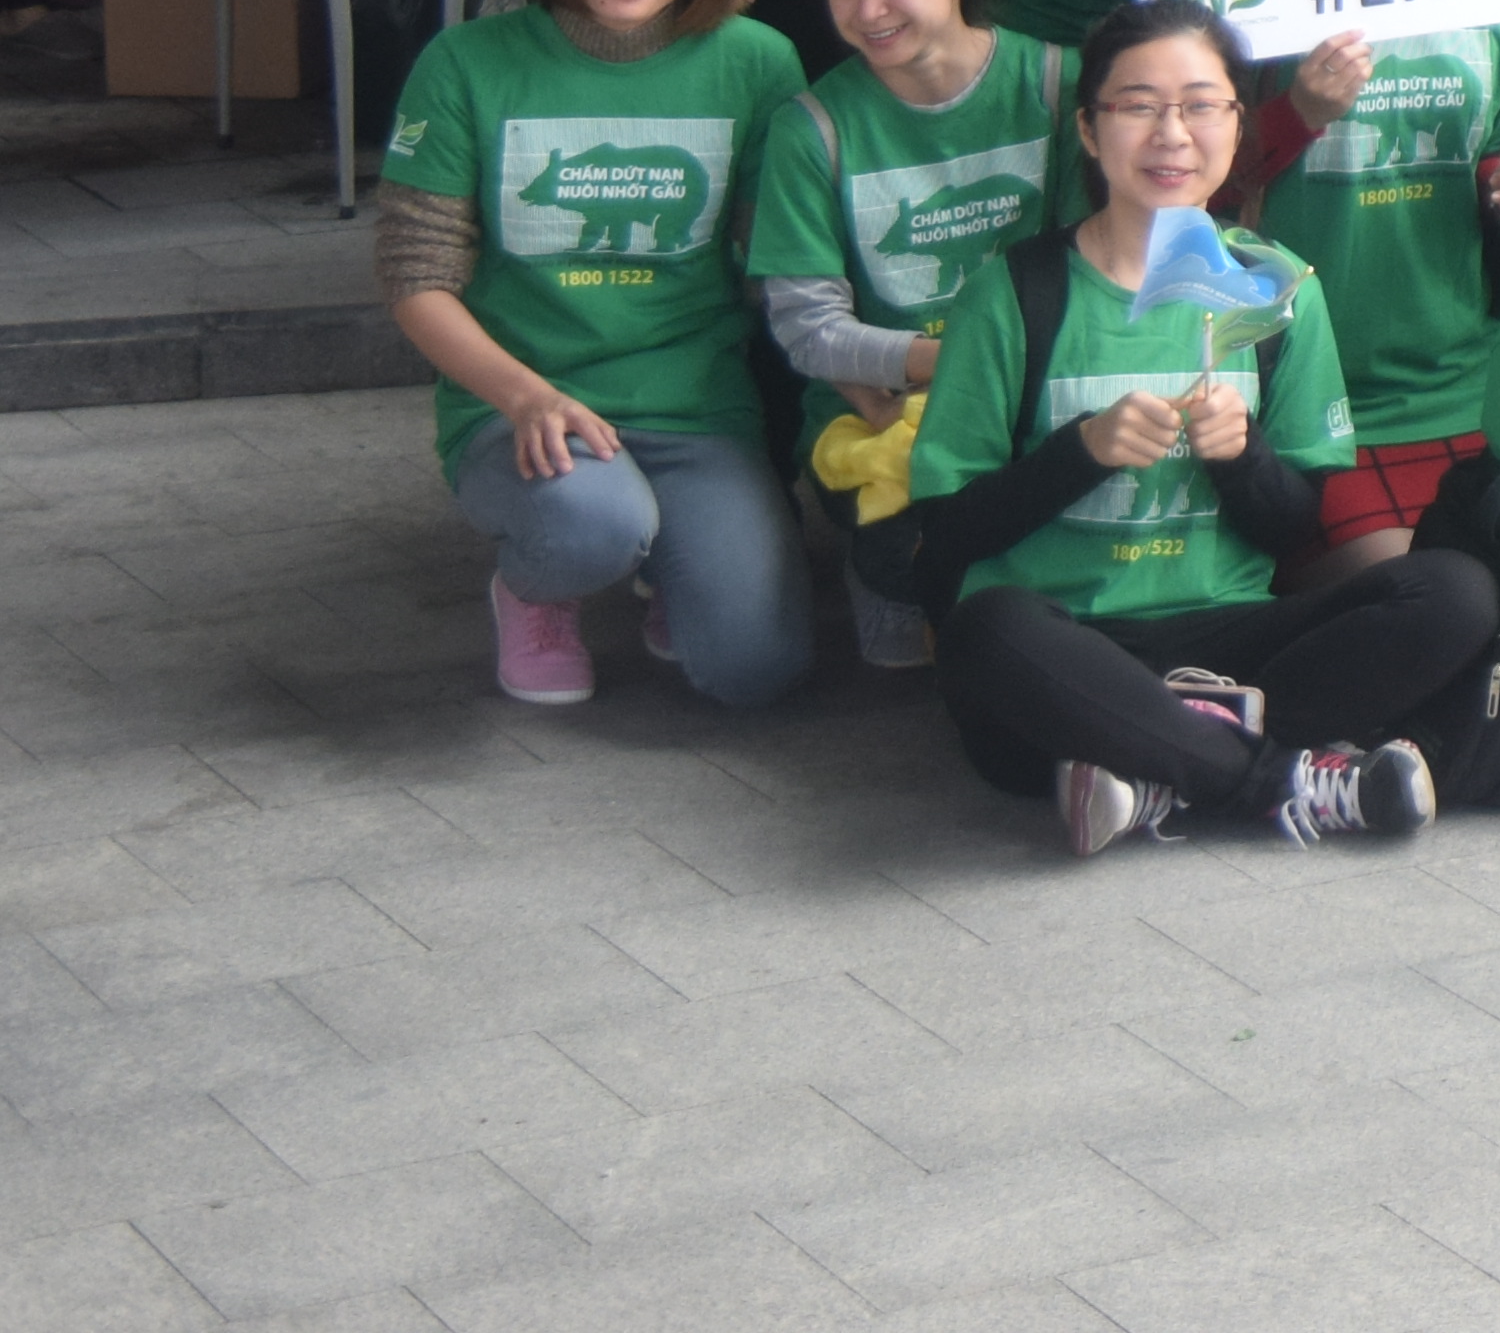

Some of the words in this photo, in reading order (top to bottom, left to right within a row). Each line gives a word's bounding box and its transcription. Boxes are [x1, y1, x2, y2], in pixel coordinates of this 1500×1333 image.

[1359, 188, 1397, 207] 1800
[559, 272, 603, 287] 1800
[608, 270, 654, 285] 1522
